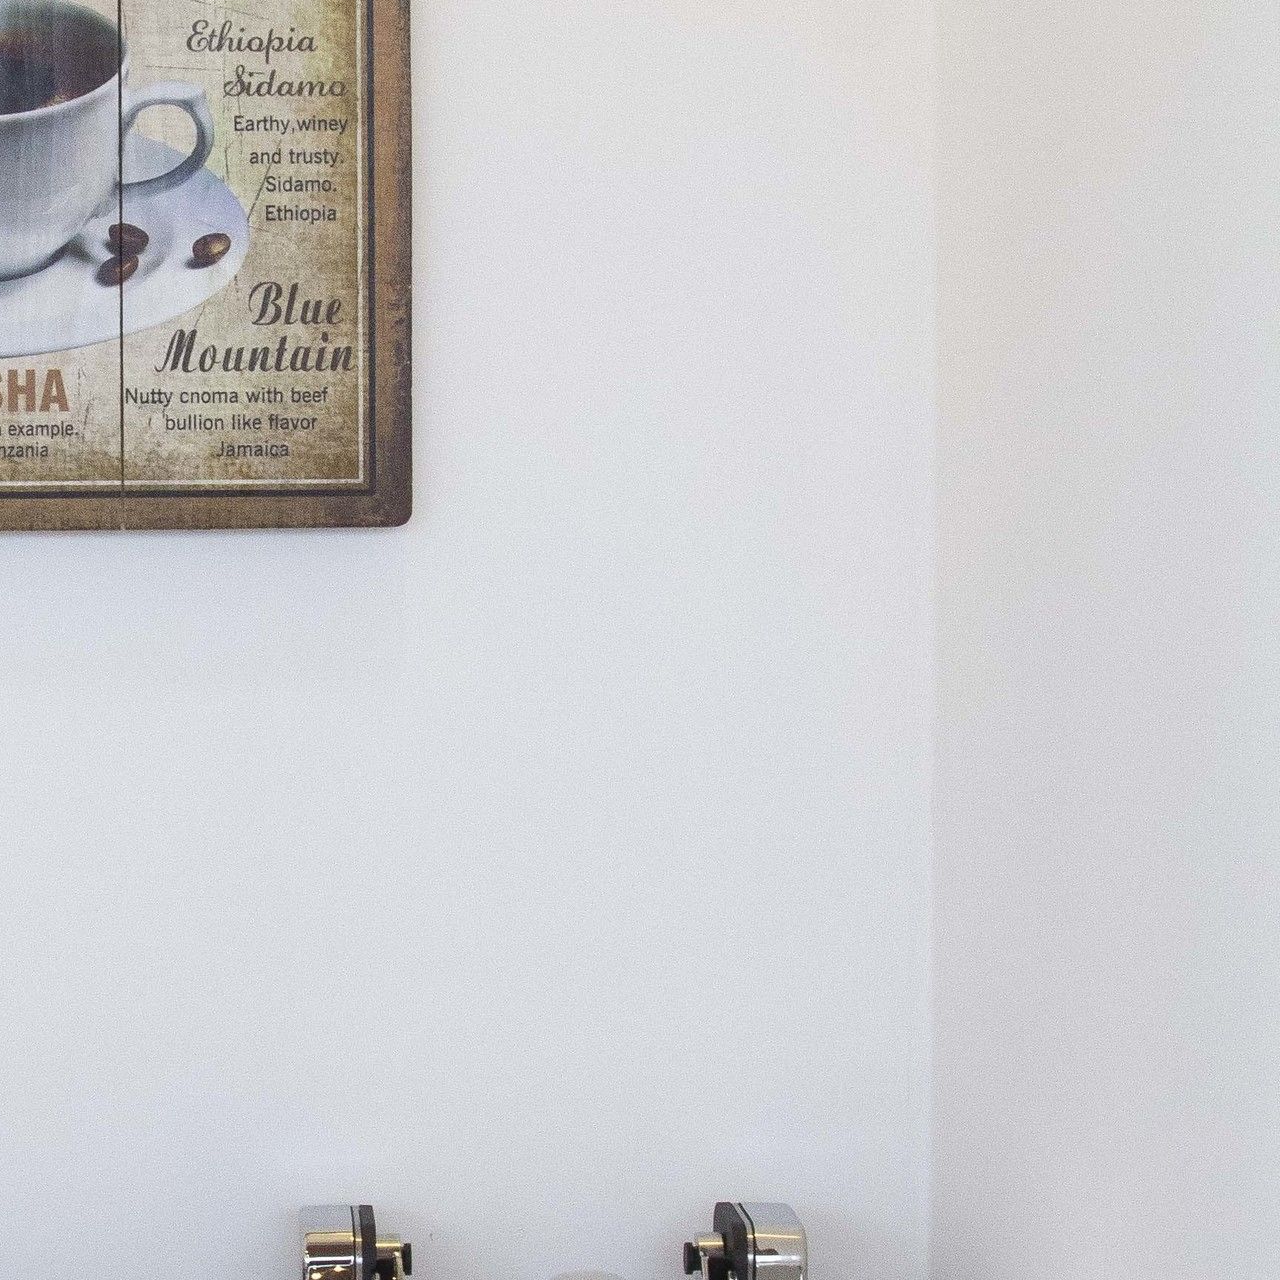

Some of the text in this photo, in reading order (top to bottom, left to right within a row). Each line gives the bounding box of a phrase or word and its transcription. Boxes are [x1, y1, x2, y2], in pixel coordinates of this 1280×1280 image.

[186, 19, 317, 65] Ethiopia
[222, 64, 348, 99] Sidamo
[249, 148, 282, 165] and
[264, 204, 338, 225] Ethiopia
[248, 280, 342, 327] Blue
[154, 328, 353, 373] Mountain
[124, 387, 173, 408] Nutty
[245, 387, 284, 403] with
[291, 386, 329, 404] beef
[165, 413, 319, 432] bullion like flavor
[216, 441, 290, 459] Jamaica
